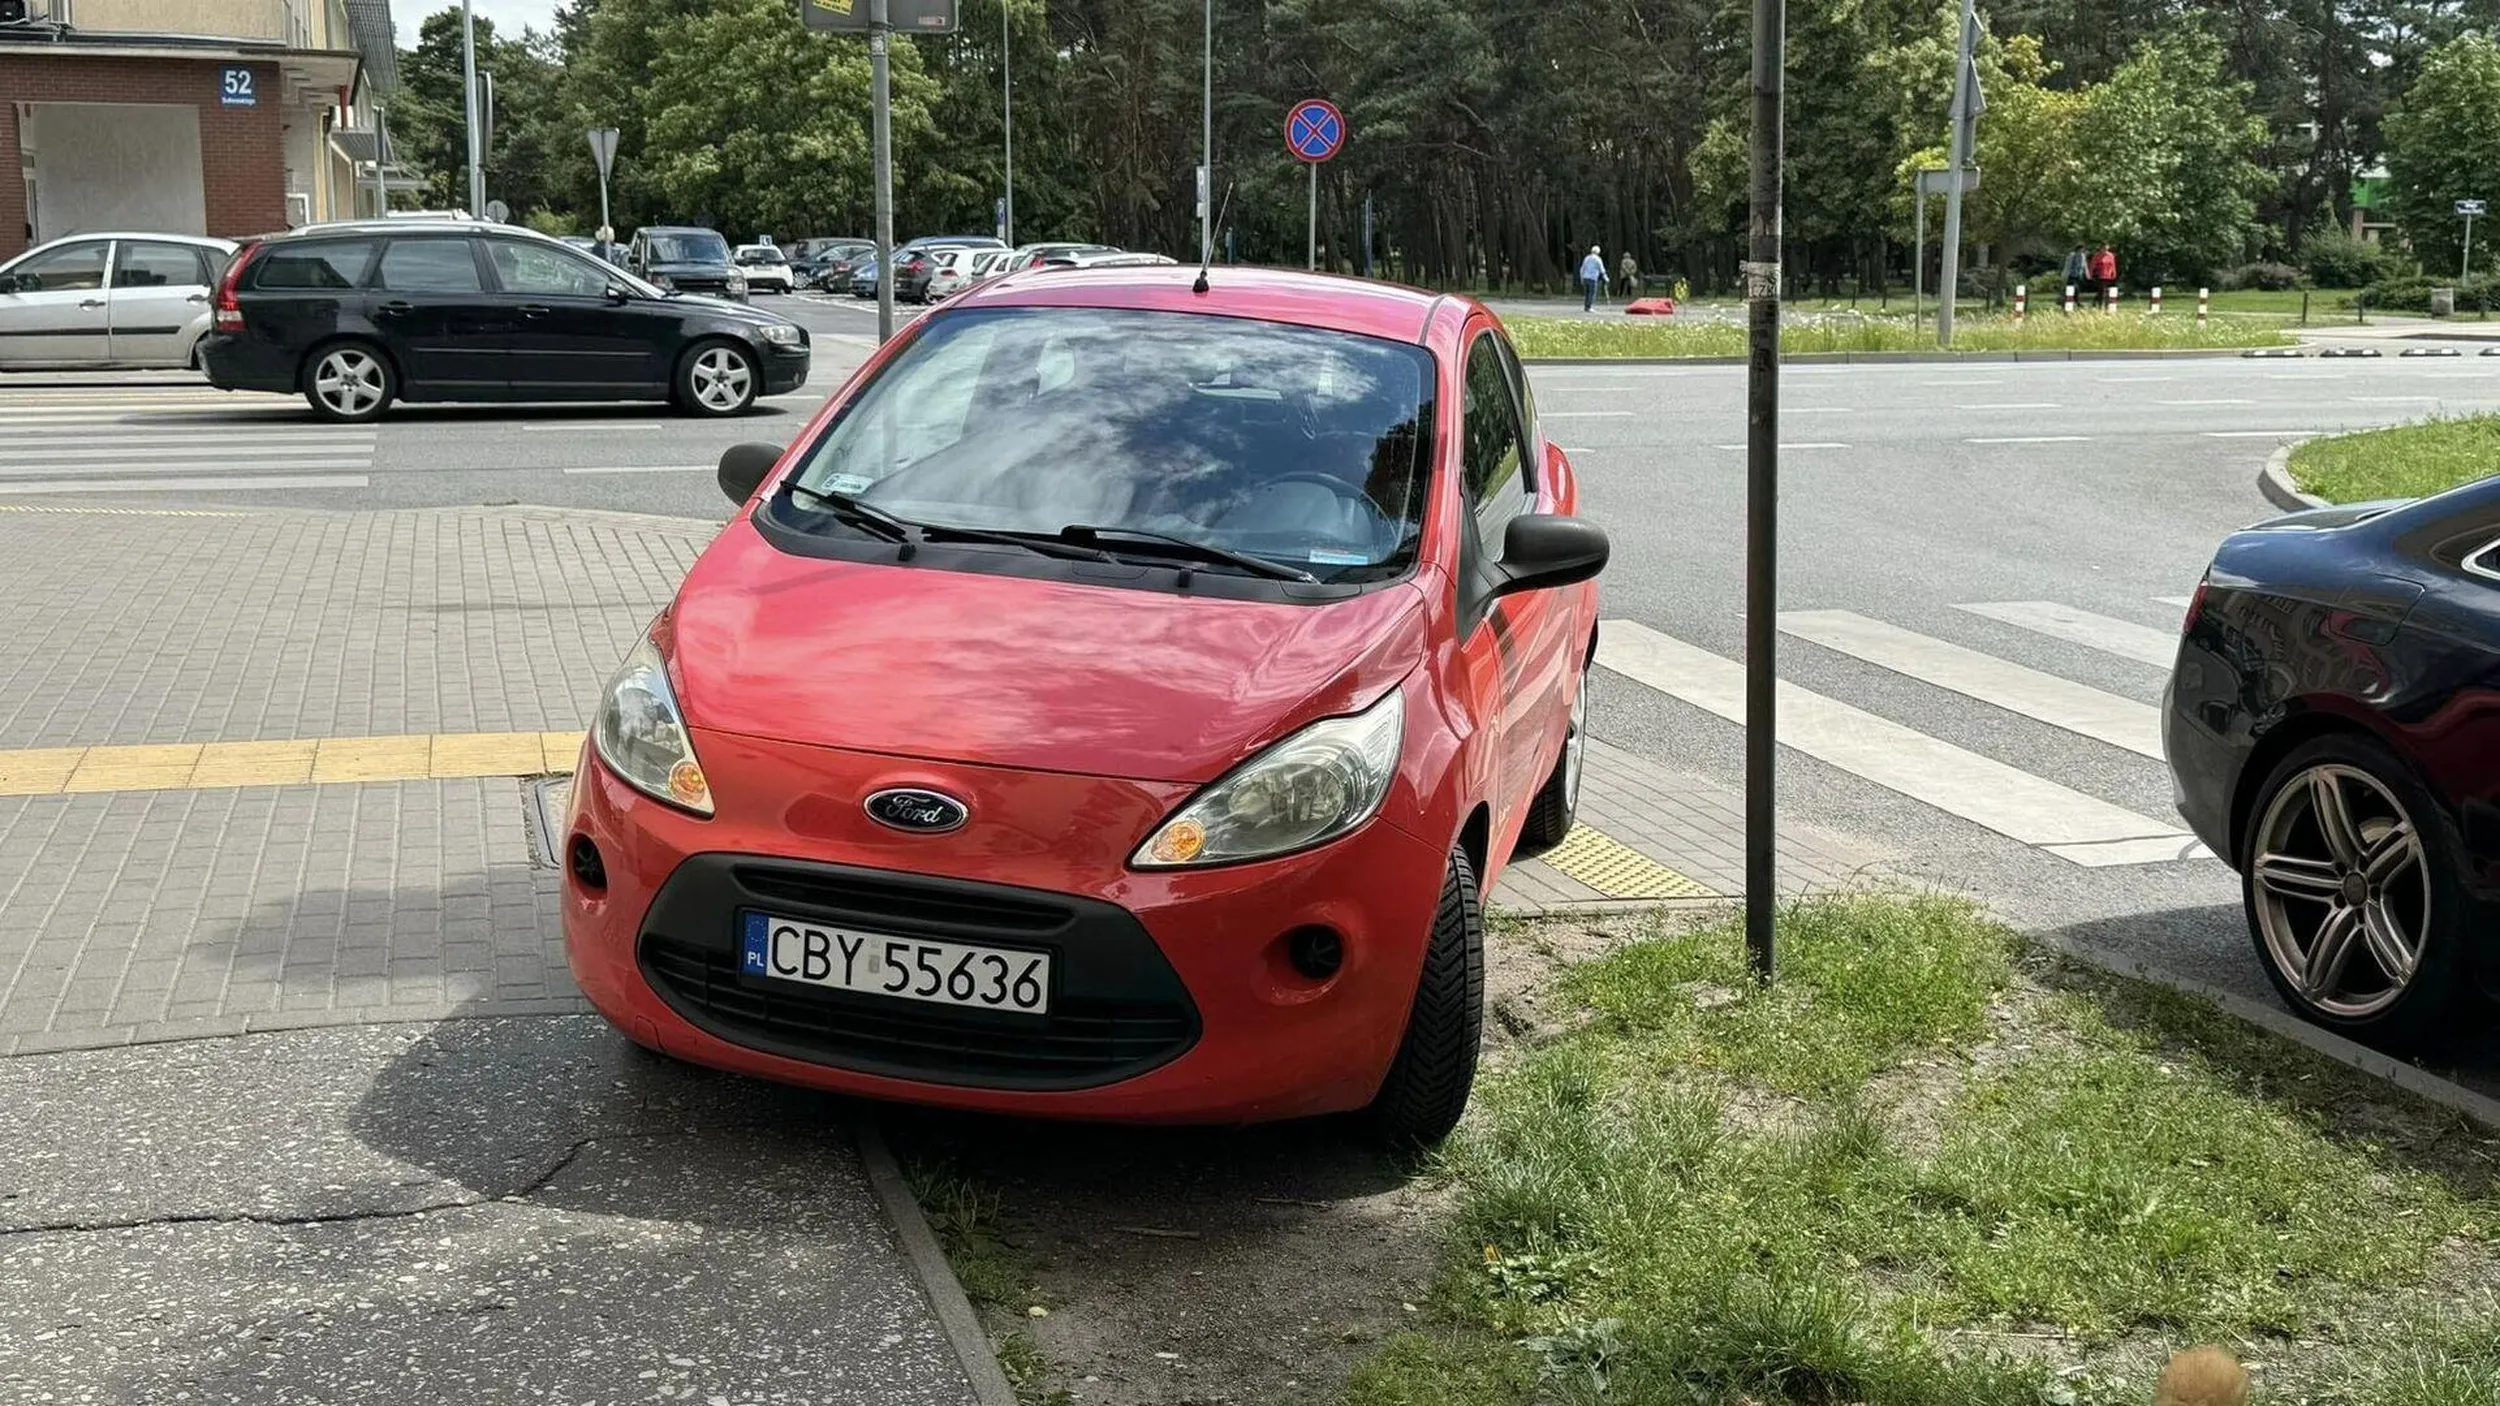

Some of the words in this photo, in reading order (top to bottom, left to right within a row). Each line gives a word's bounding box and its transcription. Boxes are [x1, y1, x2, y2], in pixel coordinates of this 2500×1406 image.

[225, 70, 252, 94] 52
[886, 794, 943, 823] Ford
[747, 951, 764, 968] PL
[771, 926, 865, 986] CBY
[883, 942, 1042, 1009] 55636
